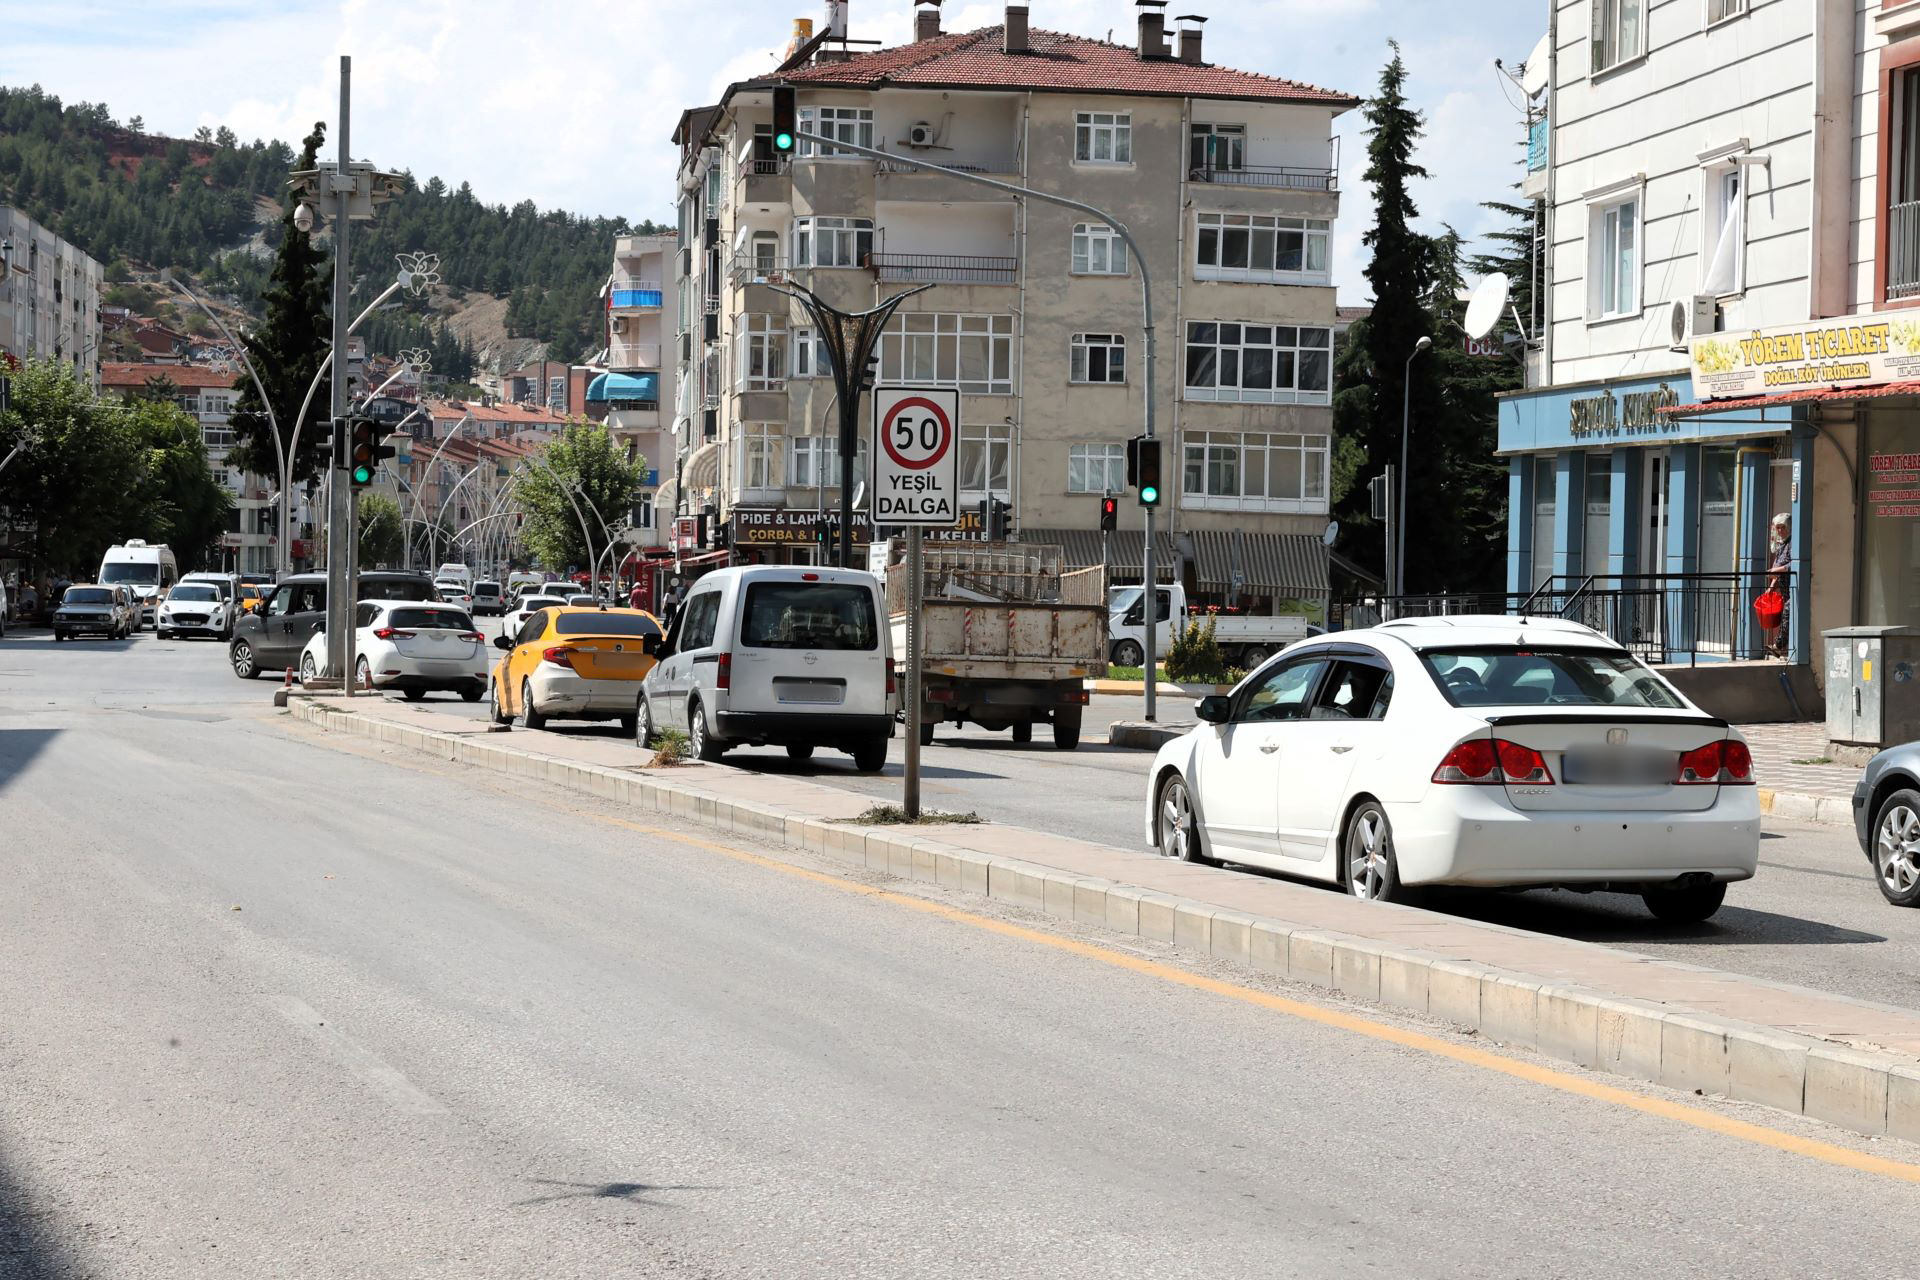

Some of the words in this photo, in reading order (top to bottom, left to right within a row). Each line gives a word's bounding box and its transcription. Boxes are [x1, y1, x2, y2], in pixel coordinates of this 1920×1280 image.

[1740, 329, 1804, 366] YÖREM
[1797, 363, 1818, 383] KÖY
[896, 417, 938, 450] 50
[889, 472, 942, 494] YEŞİL
[879, 497, 950, 514] DALGA
[775, 513, 785, 525] &
[748, 529, 793, 542] ÇORBA
[798, 529, 806, 540] &
